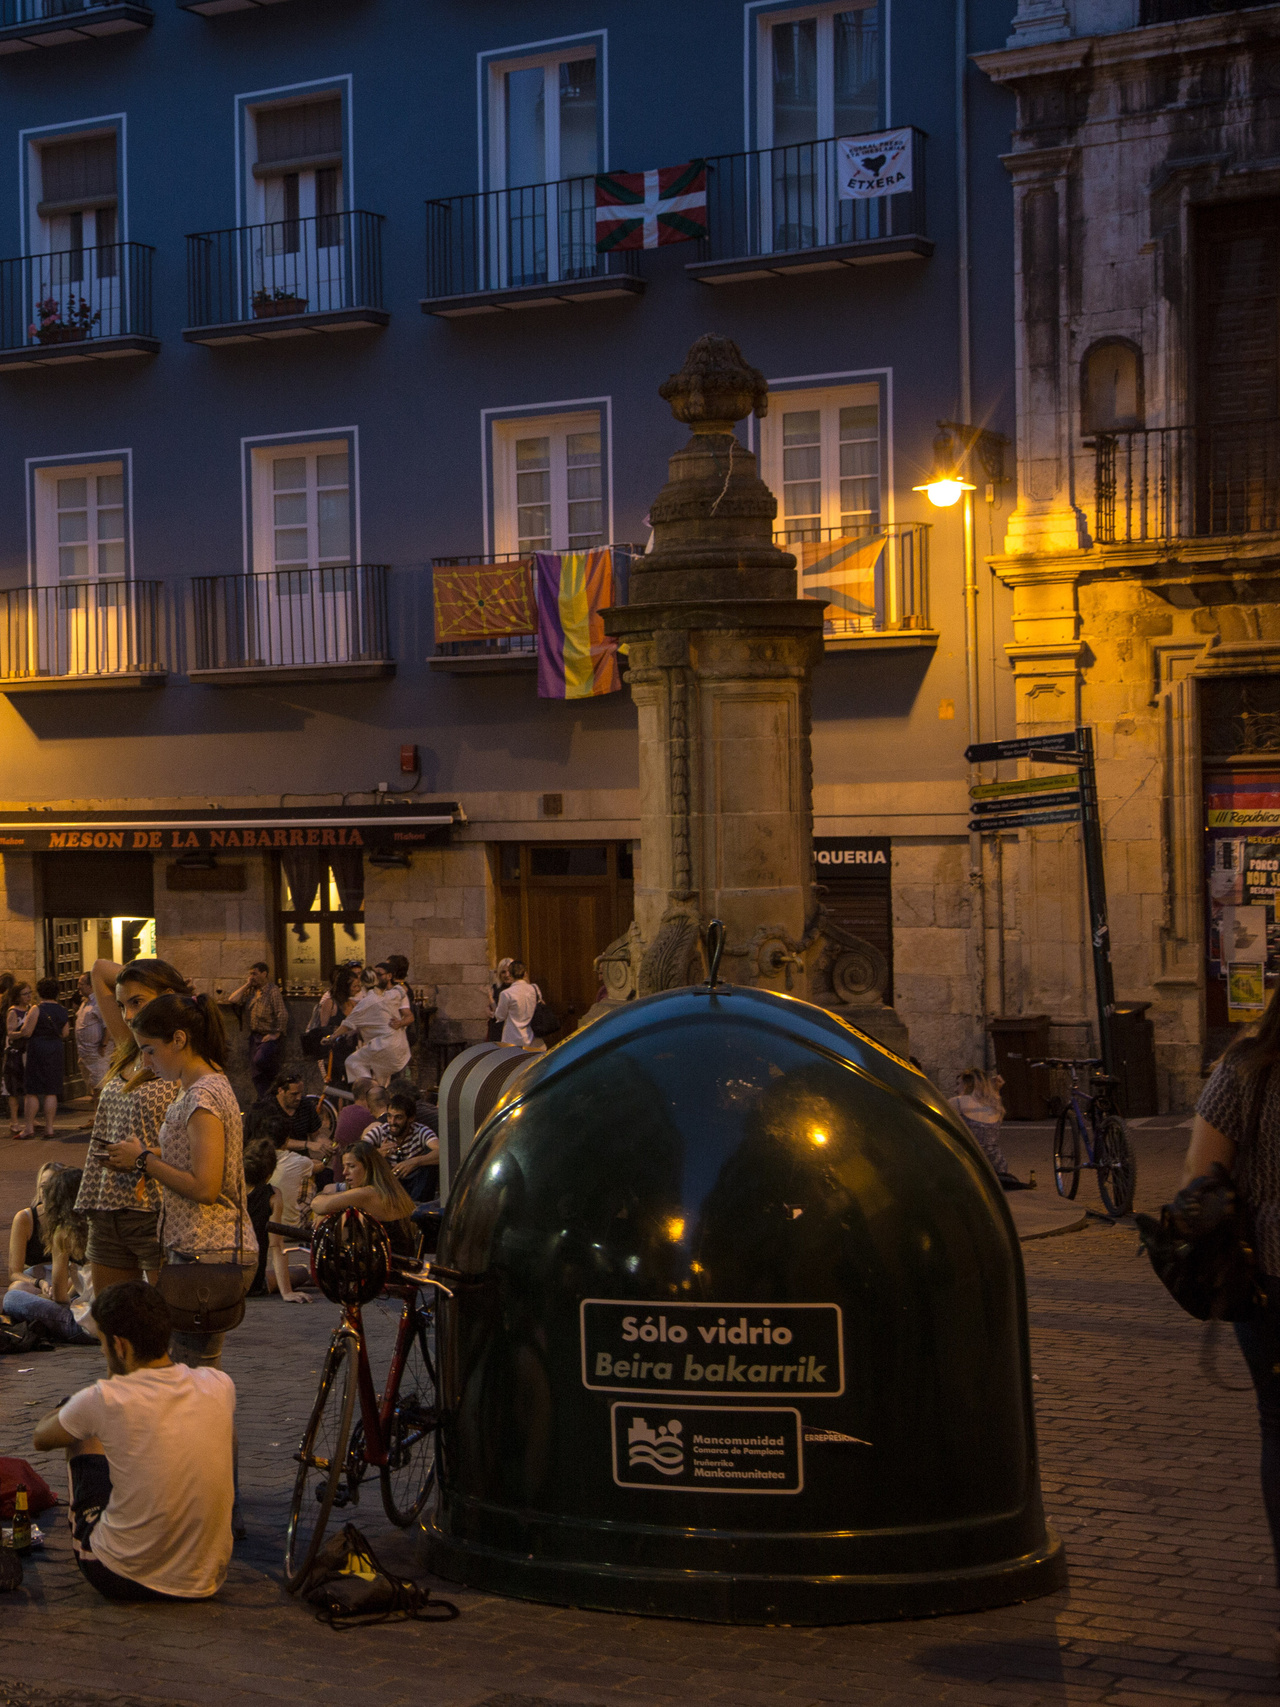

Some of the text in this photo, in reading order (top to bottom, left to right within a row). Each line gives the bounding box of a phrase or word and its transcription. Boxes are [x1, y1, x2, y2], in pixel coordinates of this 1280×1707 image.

[847, 171, 906, 190] ETXERA
[48, 831, 125, 849] MESON
[132, 831, 163, 849] DE
[170, 830, 201, 848] LA
[209, 828, 365, 848] NABARRERIA
[813, 850, 887, 865] QUERIA
[621, 1315, 793, 1345] Sólo vidrio
[594, 1352, 827, 1383] Beira bakarrik
[692, 1434, 785, 1447] Mancomunidad
[693, 1446, 785, 1457] Comarca de Pamplona
[693, 1458, 735, 1468] Iruñerriko
[694, 1467, 786, 1480] Mankomunitatea
